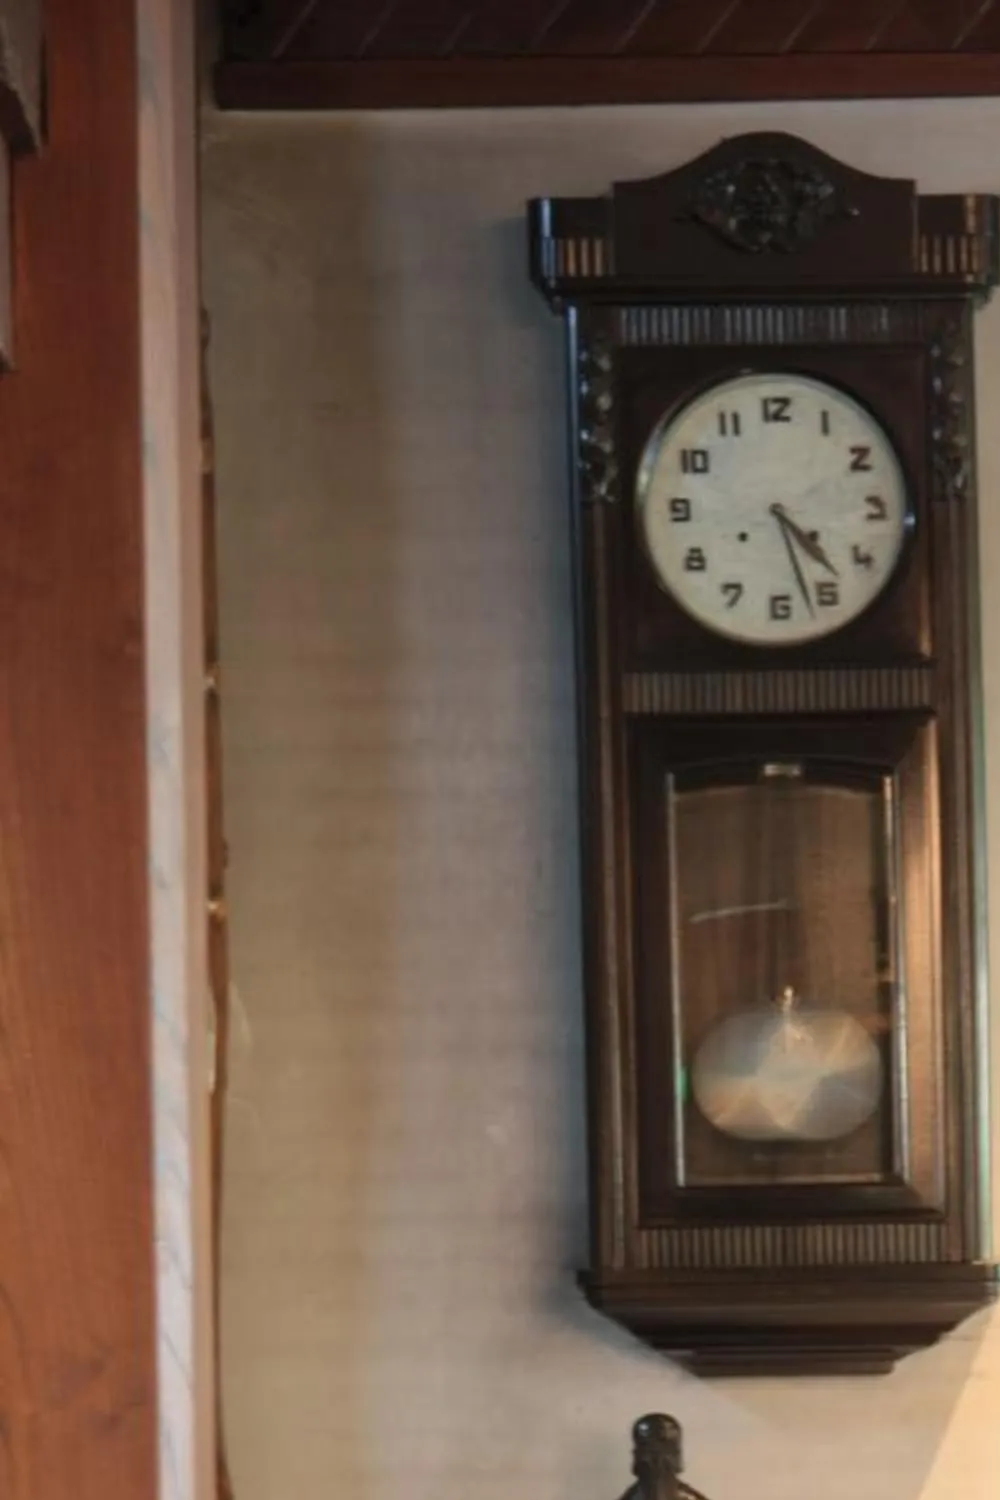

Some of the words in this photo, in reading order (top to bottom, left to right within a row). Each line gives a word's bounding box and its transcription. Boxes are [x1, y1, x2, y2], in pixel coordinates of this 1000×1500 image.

[762, 396, 791, 423] 12
[718, 411, 741, 437] 11
[821, 409, 830, 436] 1
[680, 449, 709, 474] 10
[849, 445, 873, 472] 2
[669, 498, 691, 523] 9
[864, 496, 888, 521] 3
[684, 547, 707, 572] 8
[851, 544, 875, 569] 4
[720, 582, 744, 608] 7
[815, 581, 840, 606] 5
[769, 595, 792, 620] 6
